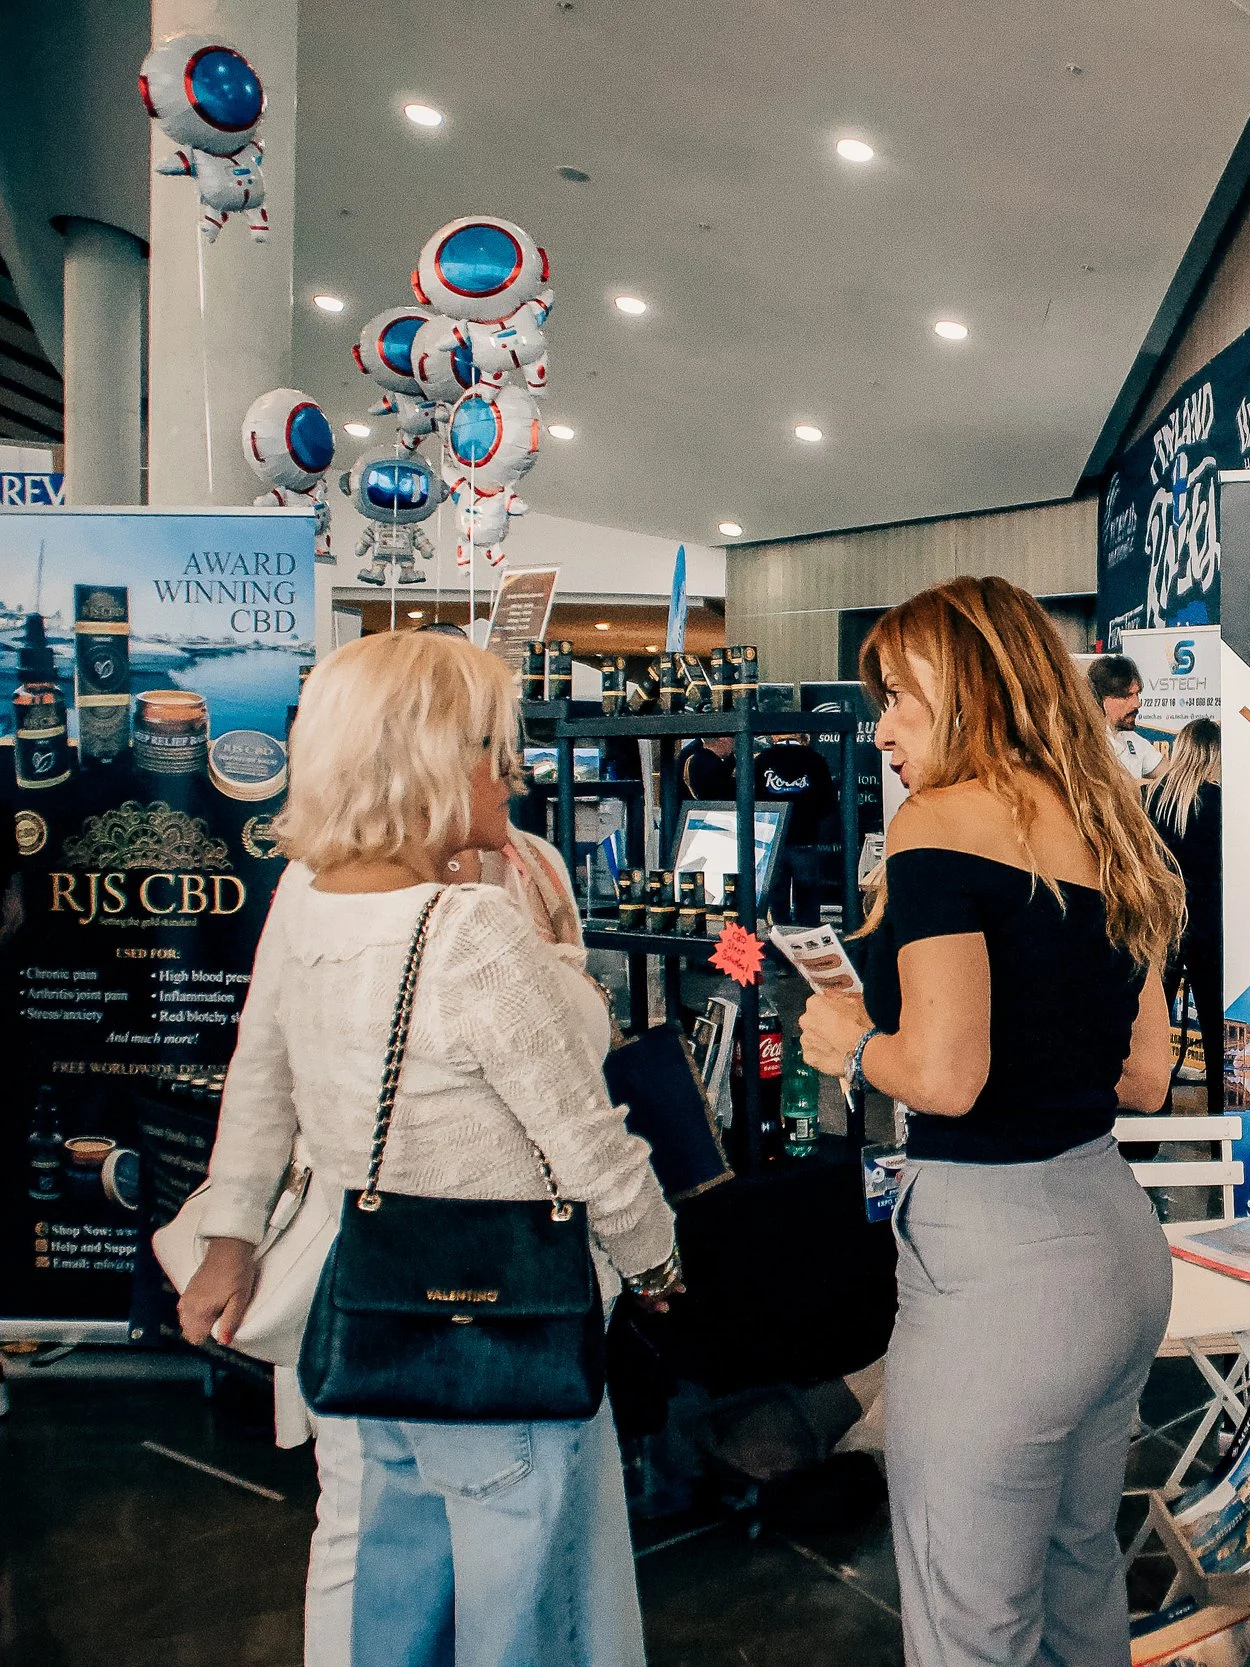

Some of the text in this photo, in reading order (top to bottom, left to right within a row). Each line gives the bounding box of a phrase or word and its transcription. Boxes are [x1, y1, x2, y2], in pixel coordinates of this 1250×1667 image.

[184, 552, 296, 576] AWARD
[154, 580, 296, 605] WINNING
[230, 609, 296, 633] CBD
[50, 873, 246, 924] RJS CBD
[159, 970, 251, 985] High blood press
[159, 989, 235, 1003] Inflammation
[104, 1242, 137, 1256] Supp
